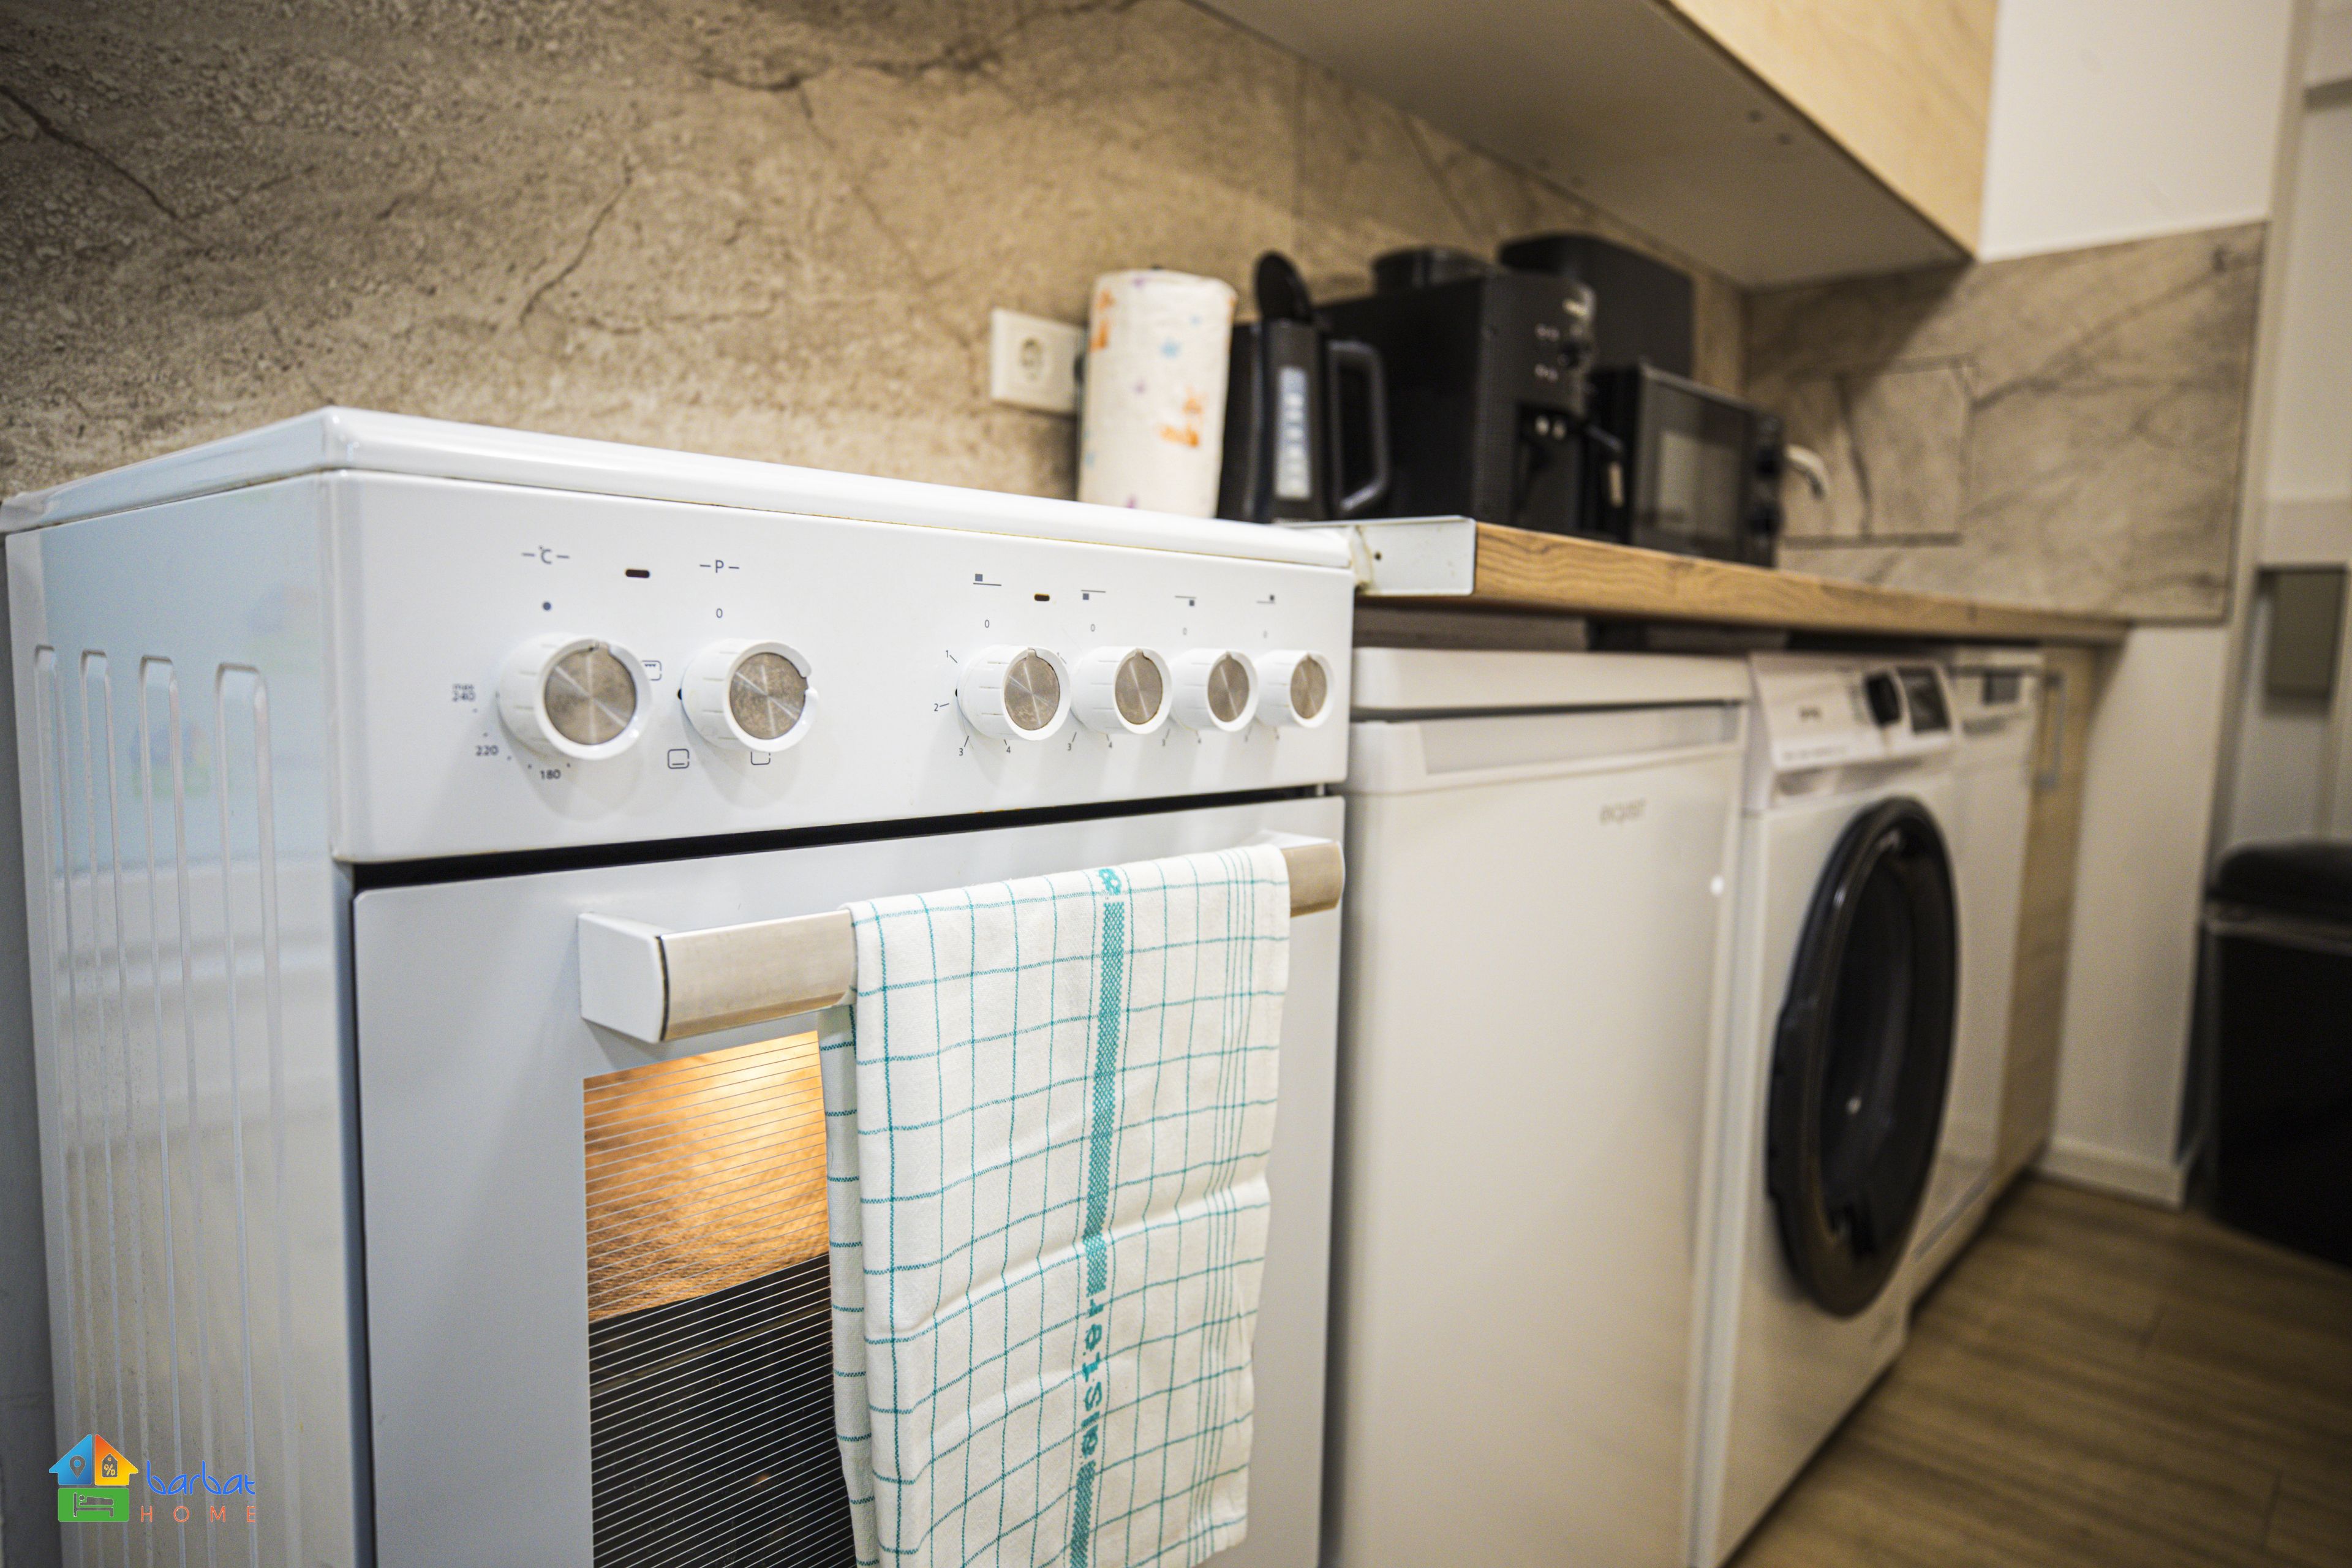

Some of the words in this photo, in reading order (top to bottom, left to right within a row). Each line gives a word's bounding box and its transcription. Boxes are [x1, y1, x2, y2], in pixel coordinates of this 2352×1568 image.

[984, 619, 990, 628] 0
[1090, 624, 1096, 632] 0
[933, 703, 938, 712] 2
[475, 745, 499, 756] 220
[959, 747, 963, 756] 3
[1006, 745, 1011, 754] 4
[540, 769, 561, 780] 180
